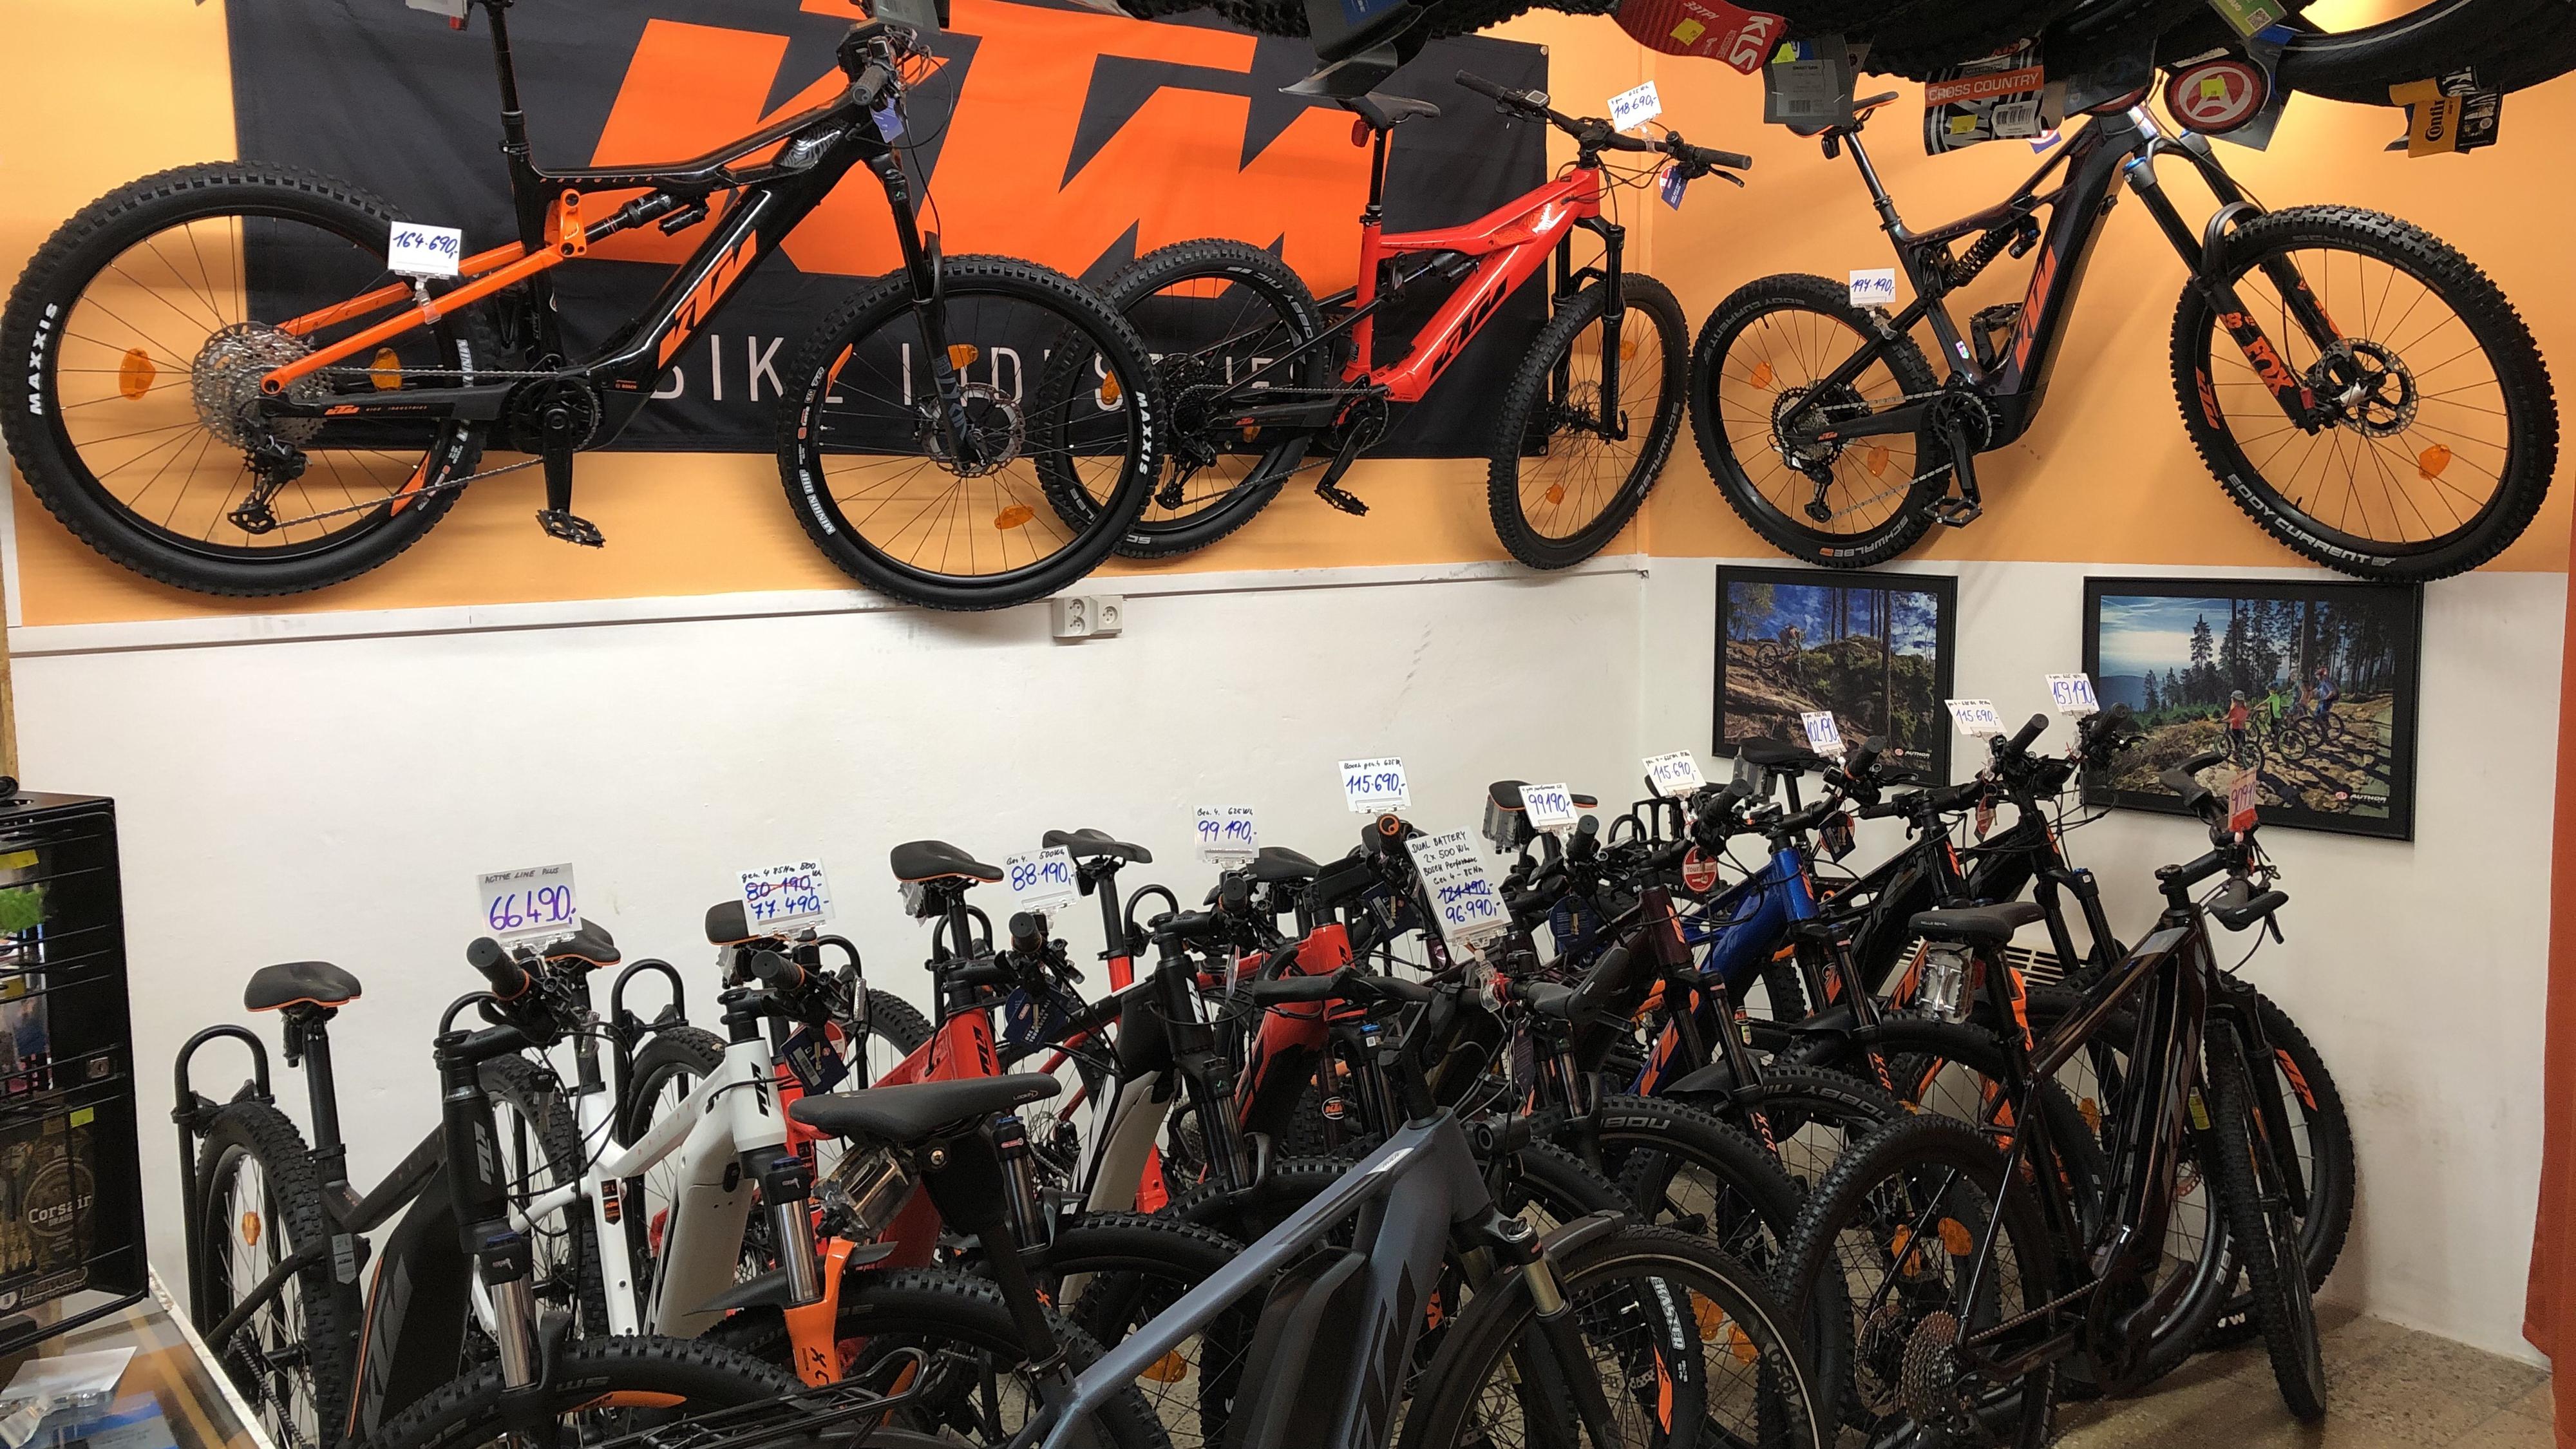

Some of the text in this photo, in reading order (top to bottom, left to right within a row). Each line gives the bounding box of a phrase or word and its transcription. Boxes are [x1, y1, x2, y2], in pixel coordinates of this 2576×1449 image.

[1728, 15, 1774, 70] KLS
[1928, 72, 2039, 102] CROSS COUNTRY
[28, 302, 59, 415] MAXXIS
[2243, 335, 2295, 397] FOX
[1135, 390, 1153, 476] MAXXIS
[1636, 401, 1680, 498] SCHWALBE
[1833, 514, 1909, 558] SCHWALBE
[2227, 473, 2371, 564] EDDY CURRENT
[1905, 750, 1931, 759] AUTHOR
[2349, 793, 2387, 803] AUTHOR
[1411, 830, 1467, 854] DUAL BATTERY
[1438, 848, 1456, 859] 500
[514, 869, 536, 879] LINE
[542, 867, 560, 876] PLUS
